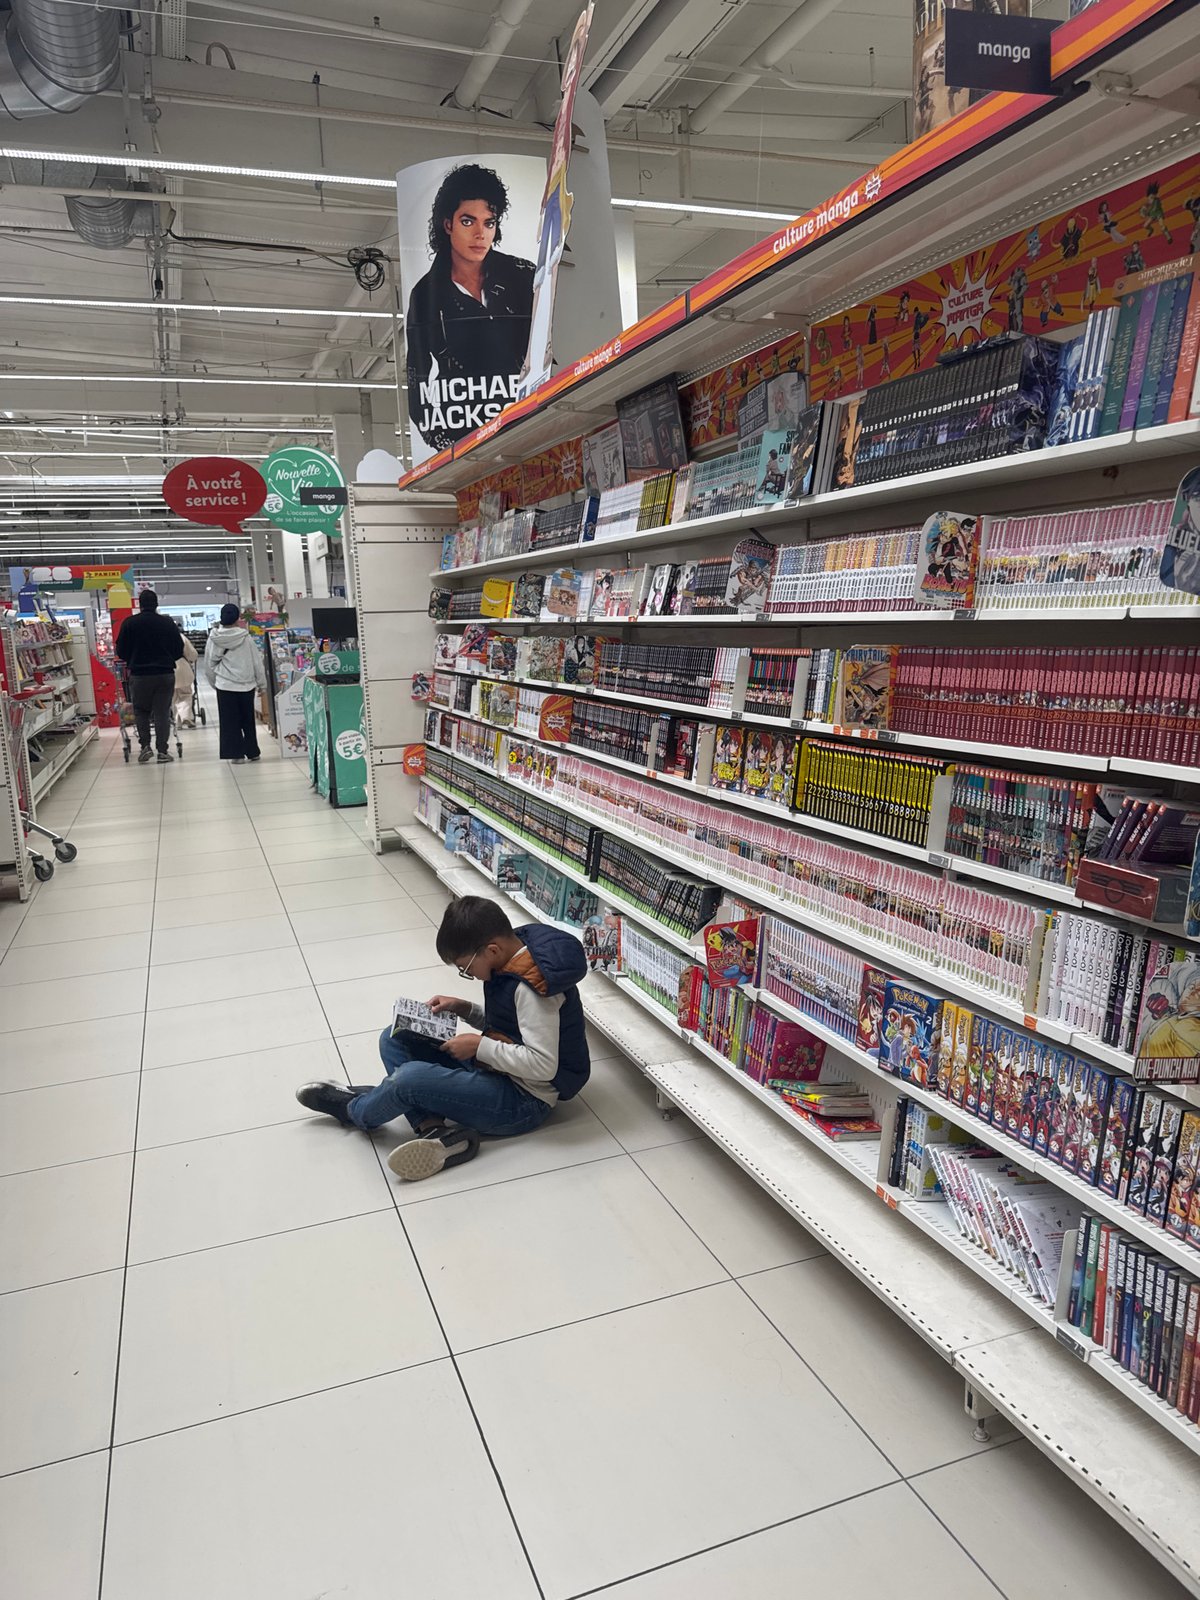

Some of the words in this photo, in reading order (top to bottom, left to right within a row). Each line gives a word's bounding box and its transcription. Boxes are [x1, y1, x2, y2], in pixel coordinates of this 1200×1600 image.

[978, 41, 1031, 63] manga
[773, 228, 815, 254] culture
[816, 190, 859, 219] manga
[948, 287, 985, 308] CULTURE
[947, 301, 984, 327] MANGA
[419, 403, 515, 432] JACKS
[275, 464, 321, 481] Nouvelle
[186, 475, 198, 491] À
[201, 477, 242, 490] votre
[185, 492, 240, 507] service
[242, 492, 247, 505] !
[312, 493, 336, 501] manga
[323, 663, 339, 673] 5€
[343, 743, 364, 758] 5€
[925, 1016, 932, 1024] 2
[1135, 1058, 1182, 1079] ONE-PUNCH
[1181, 1058, 1200, 1079] MAN
